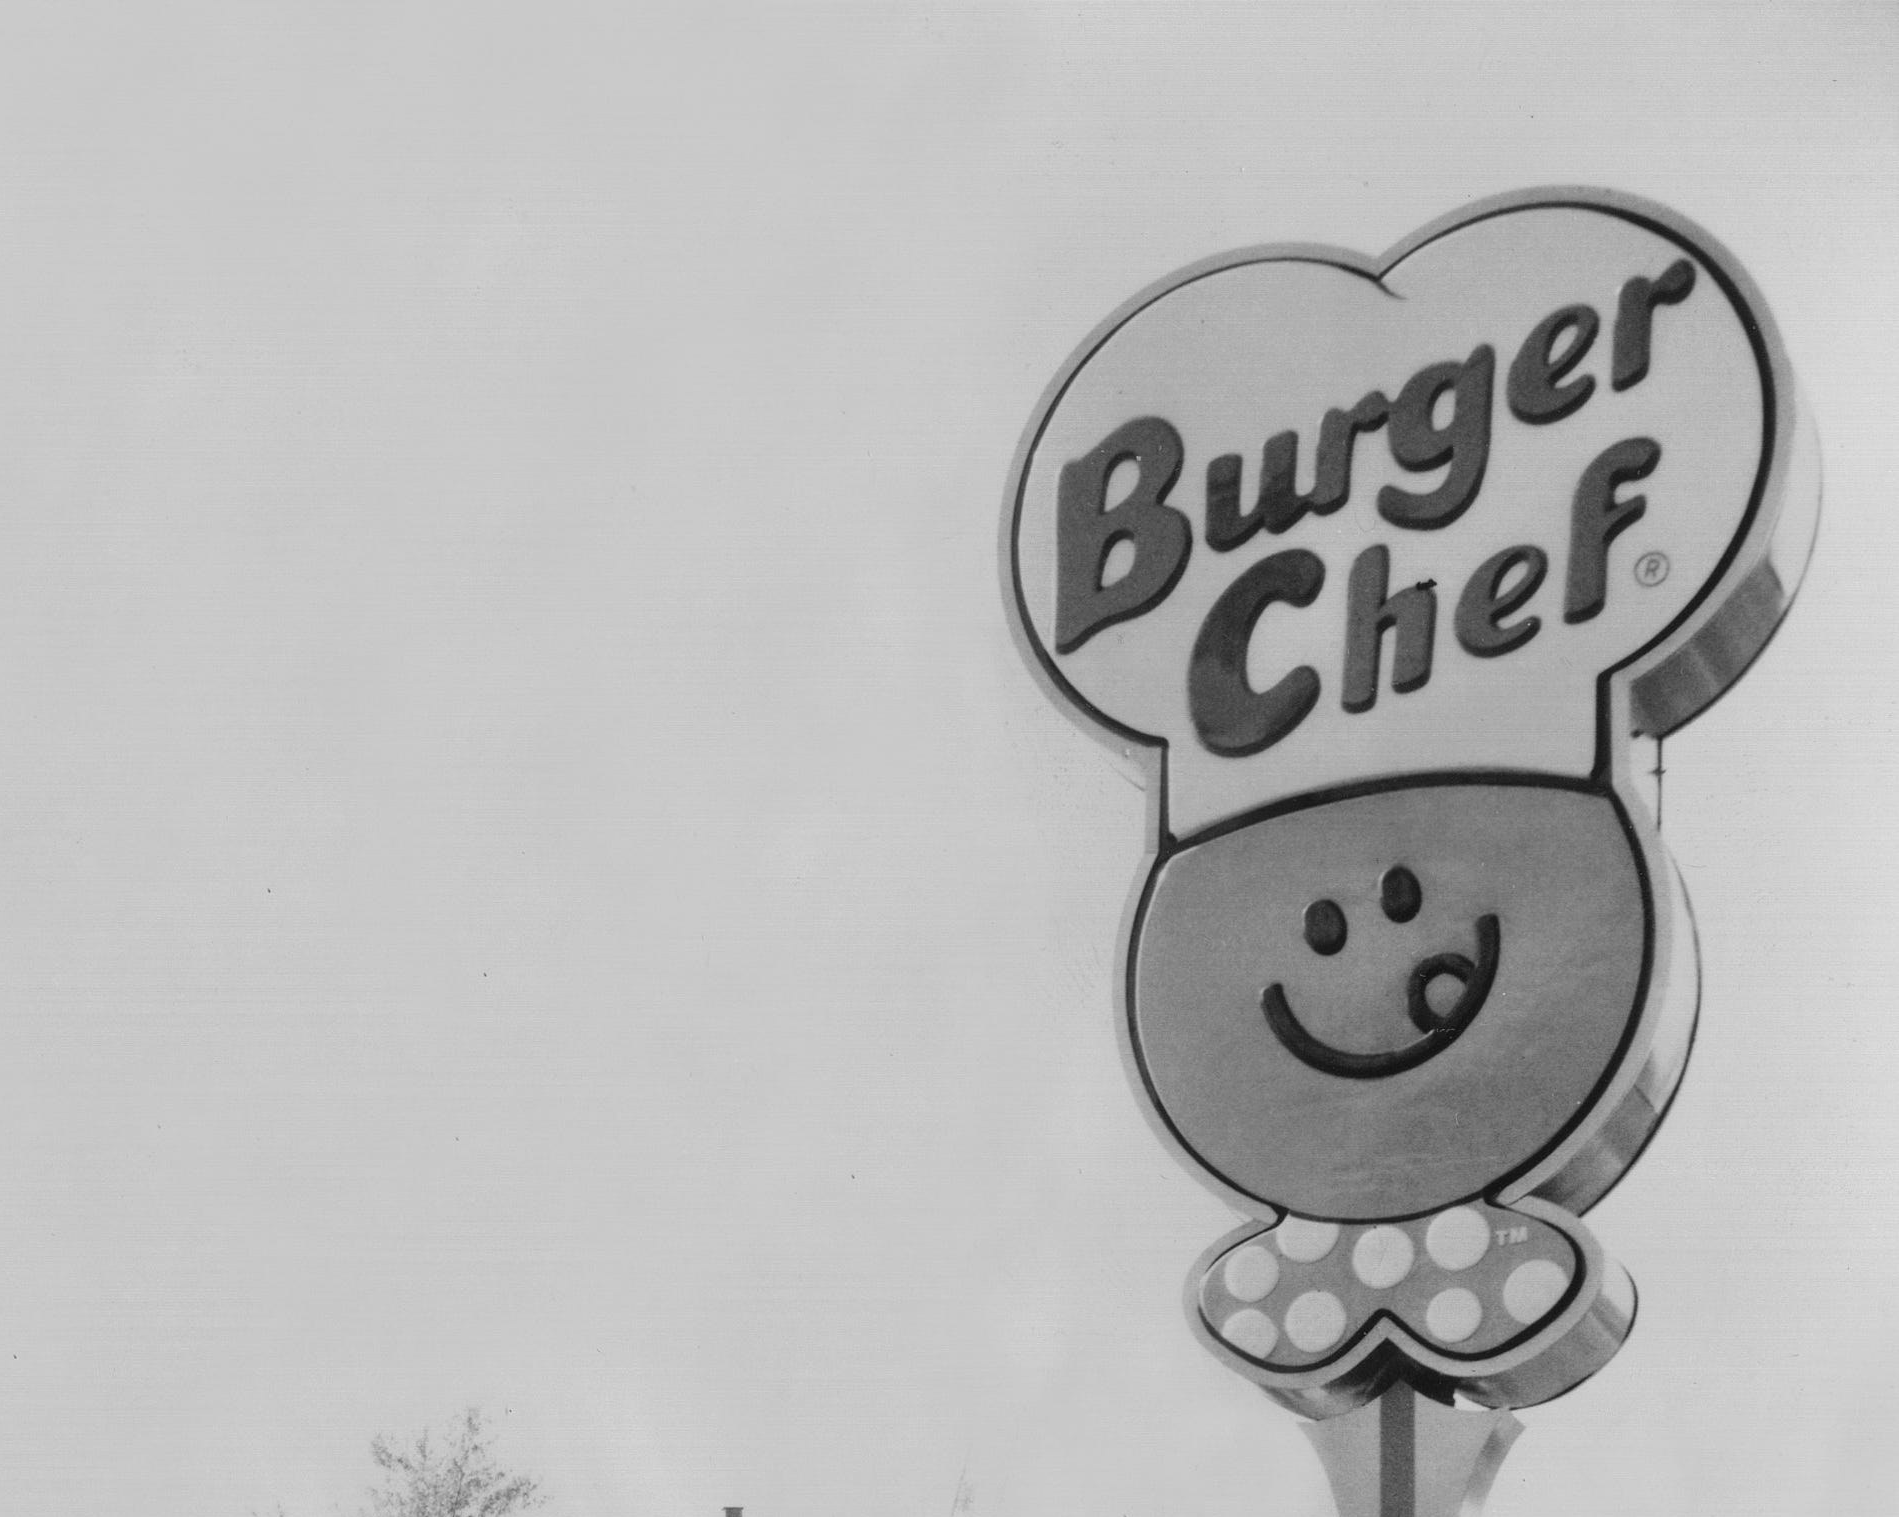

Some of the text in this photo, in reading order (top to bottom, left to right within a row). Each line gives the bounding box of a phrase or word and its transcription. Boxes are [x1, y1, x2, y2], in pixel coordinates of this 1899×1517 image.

[1055, 258, 1698, 656] Burger
[1187, 436, 1663, 759] Chef
[1496, 1226, 1528, 1246] TM
